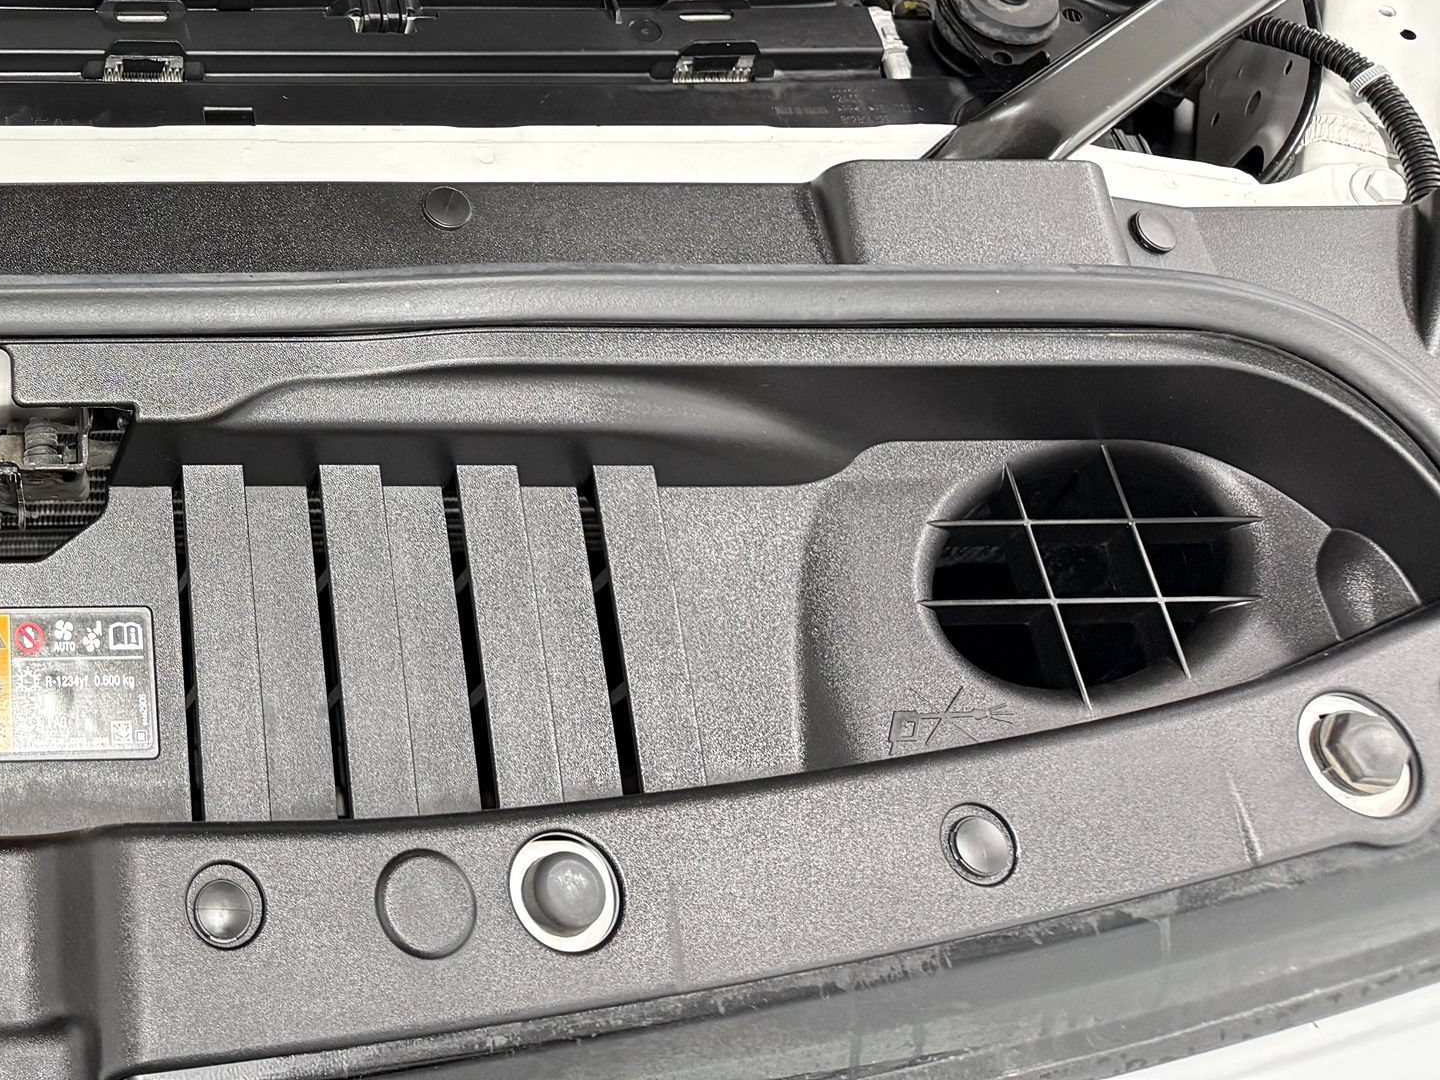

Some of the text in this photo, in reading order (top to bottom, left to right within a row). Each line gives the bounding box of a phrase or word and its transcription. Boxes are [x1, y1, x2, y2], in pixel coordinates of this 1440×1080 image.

[53, 641, 76, 652] AUTO
[45, 675, 89, 689] R-1234yf
[122, 675, 135, 689] kg
